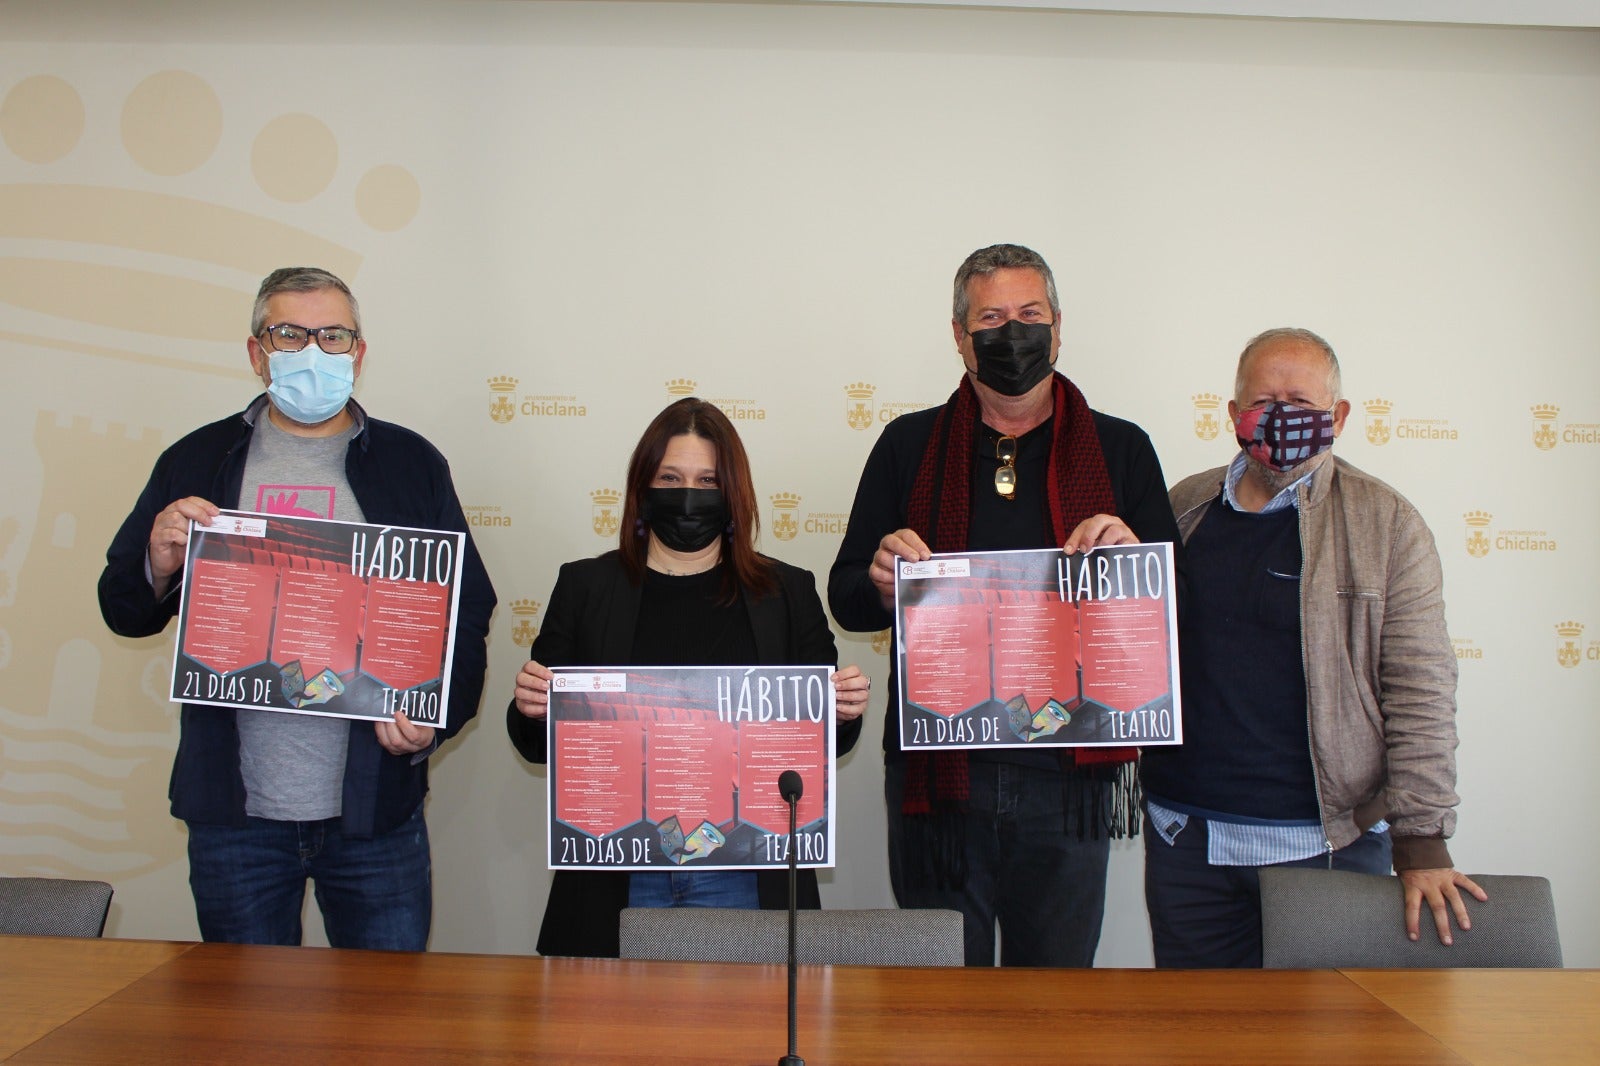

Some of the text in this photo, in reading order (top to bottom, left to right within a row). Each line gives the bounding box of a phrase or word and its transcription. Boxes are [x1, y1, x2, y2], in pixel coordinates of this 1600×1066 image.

[521, 402, 587, 417] Chiclana
[1396, 425, 1459, 440] Chiclana
[351, 527, 452, 587] HÁBITO
[1495, 536, 1557, 551] Chiclana
[1057, 547, 1163, 604] HÁBITO
[182, 670, 273, 704] 21 DÍAS DE
[717, 667, 824, 723] HÁBITO
[382, 687, 438, 721] TEATRO
[912, 713, 1001, 744] 21 DÍAS DE
[1108, 708, 1171, 739] TEATRO
[560, 833, 652, 864] 21 DÍAS DE
